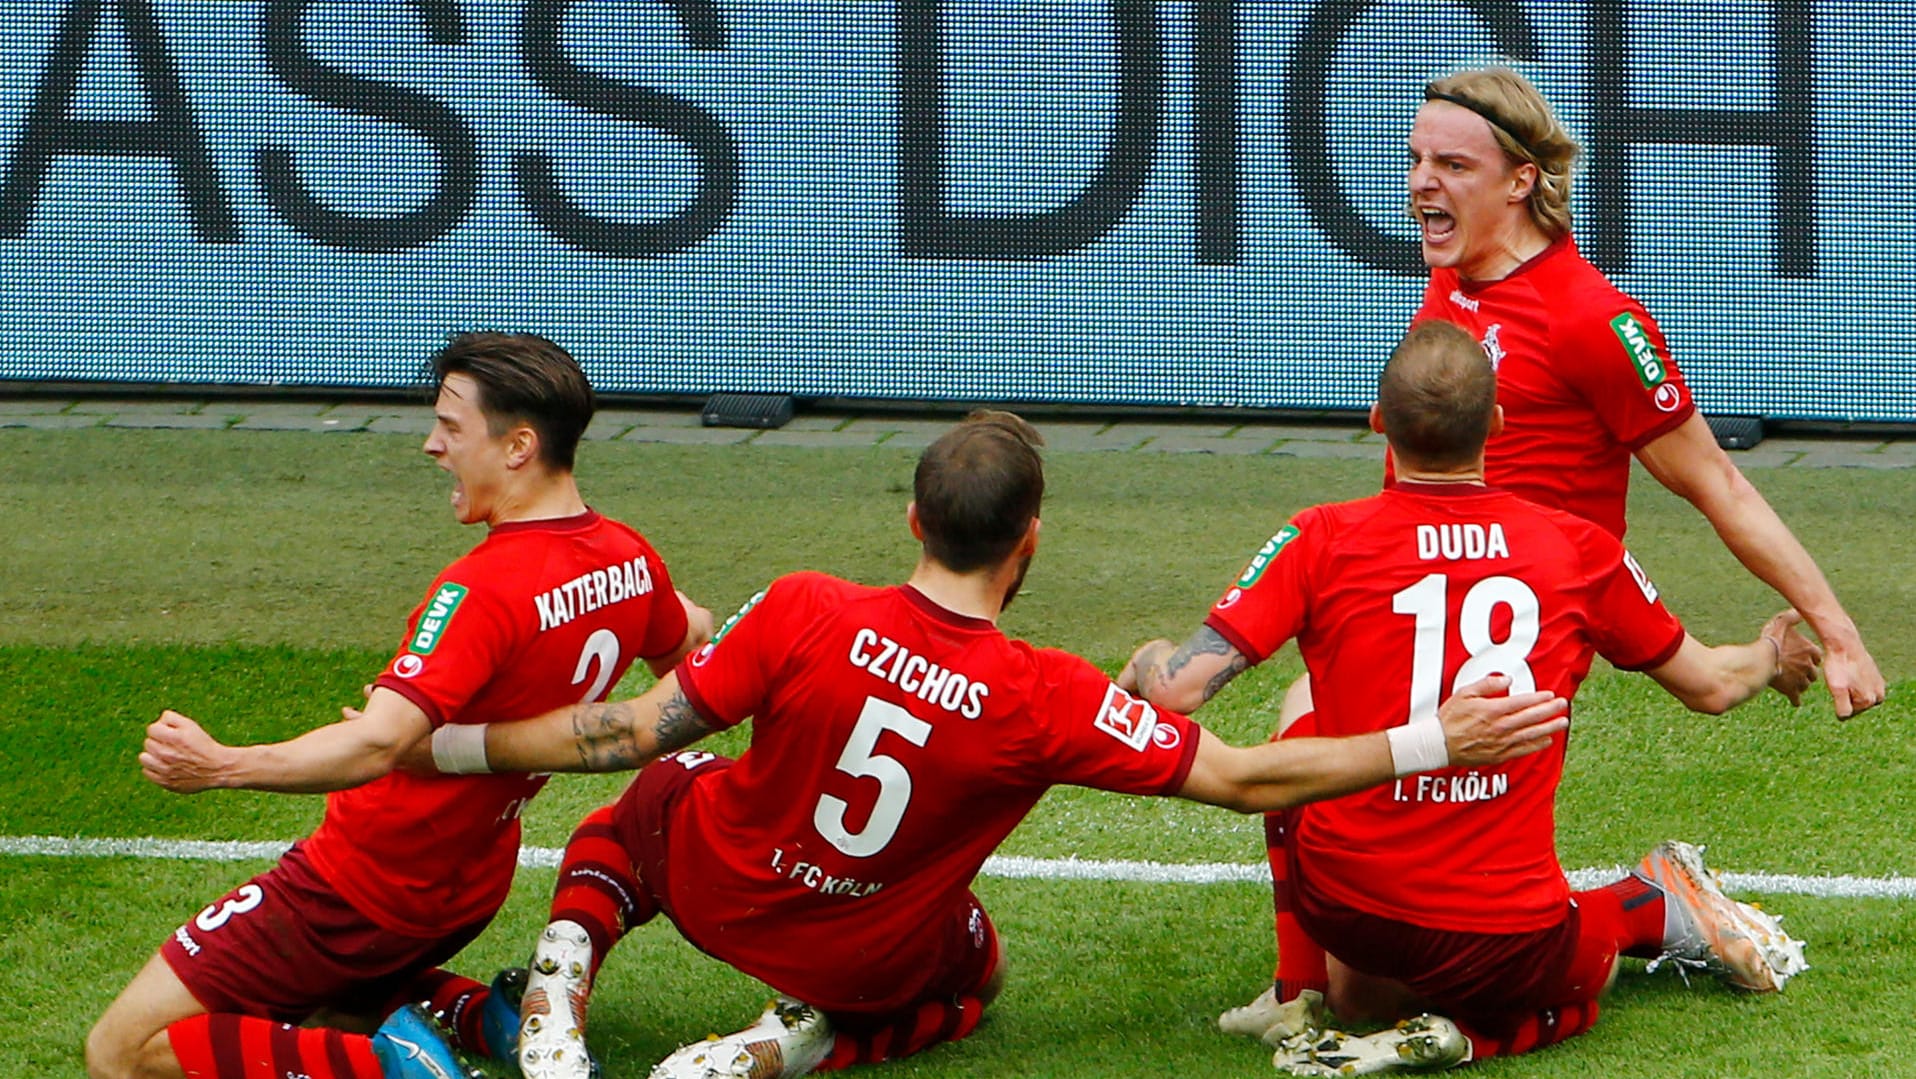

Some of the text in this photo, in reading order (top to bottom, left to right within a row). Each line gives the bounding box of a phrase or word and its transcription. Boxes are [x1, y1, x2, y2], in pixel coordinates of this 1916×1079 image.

[898, 0, 1818, 279] DICH
[1618, 317, 1662, 382] DEVK
[1240, 526, 1292, 582] DEVK
[1416, 522, 1509, 561] DUDA
[415, 587, 461, 650] DEVK
[1391, 572, 1542, 727] 18
[849, 627, 990, 720] CZICHOS
[813, 695, 932, 859] 5
[1416, 775, 1448, 803] FC
[1449, 770, 1508, 804] KÖLN
[195, 883, 265, 933] 3
[788, 861, 823, 890] FC
[818, 875, 885, 898] KÖLN
